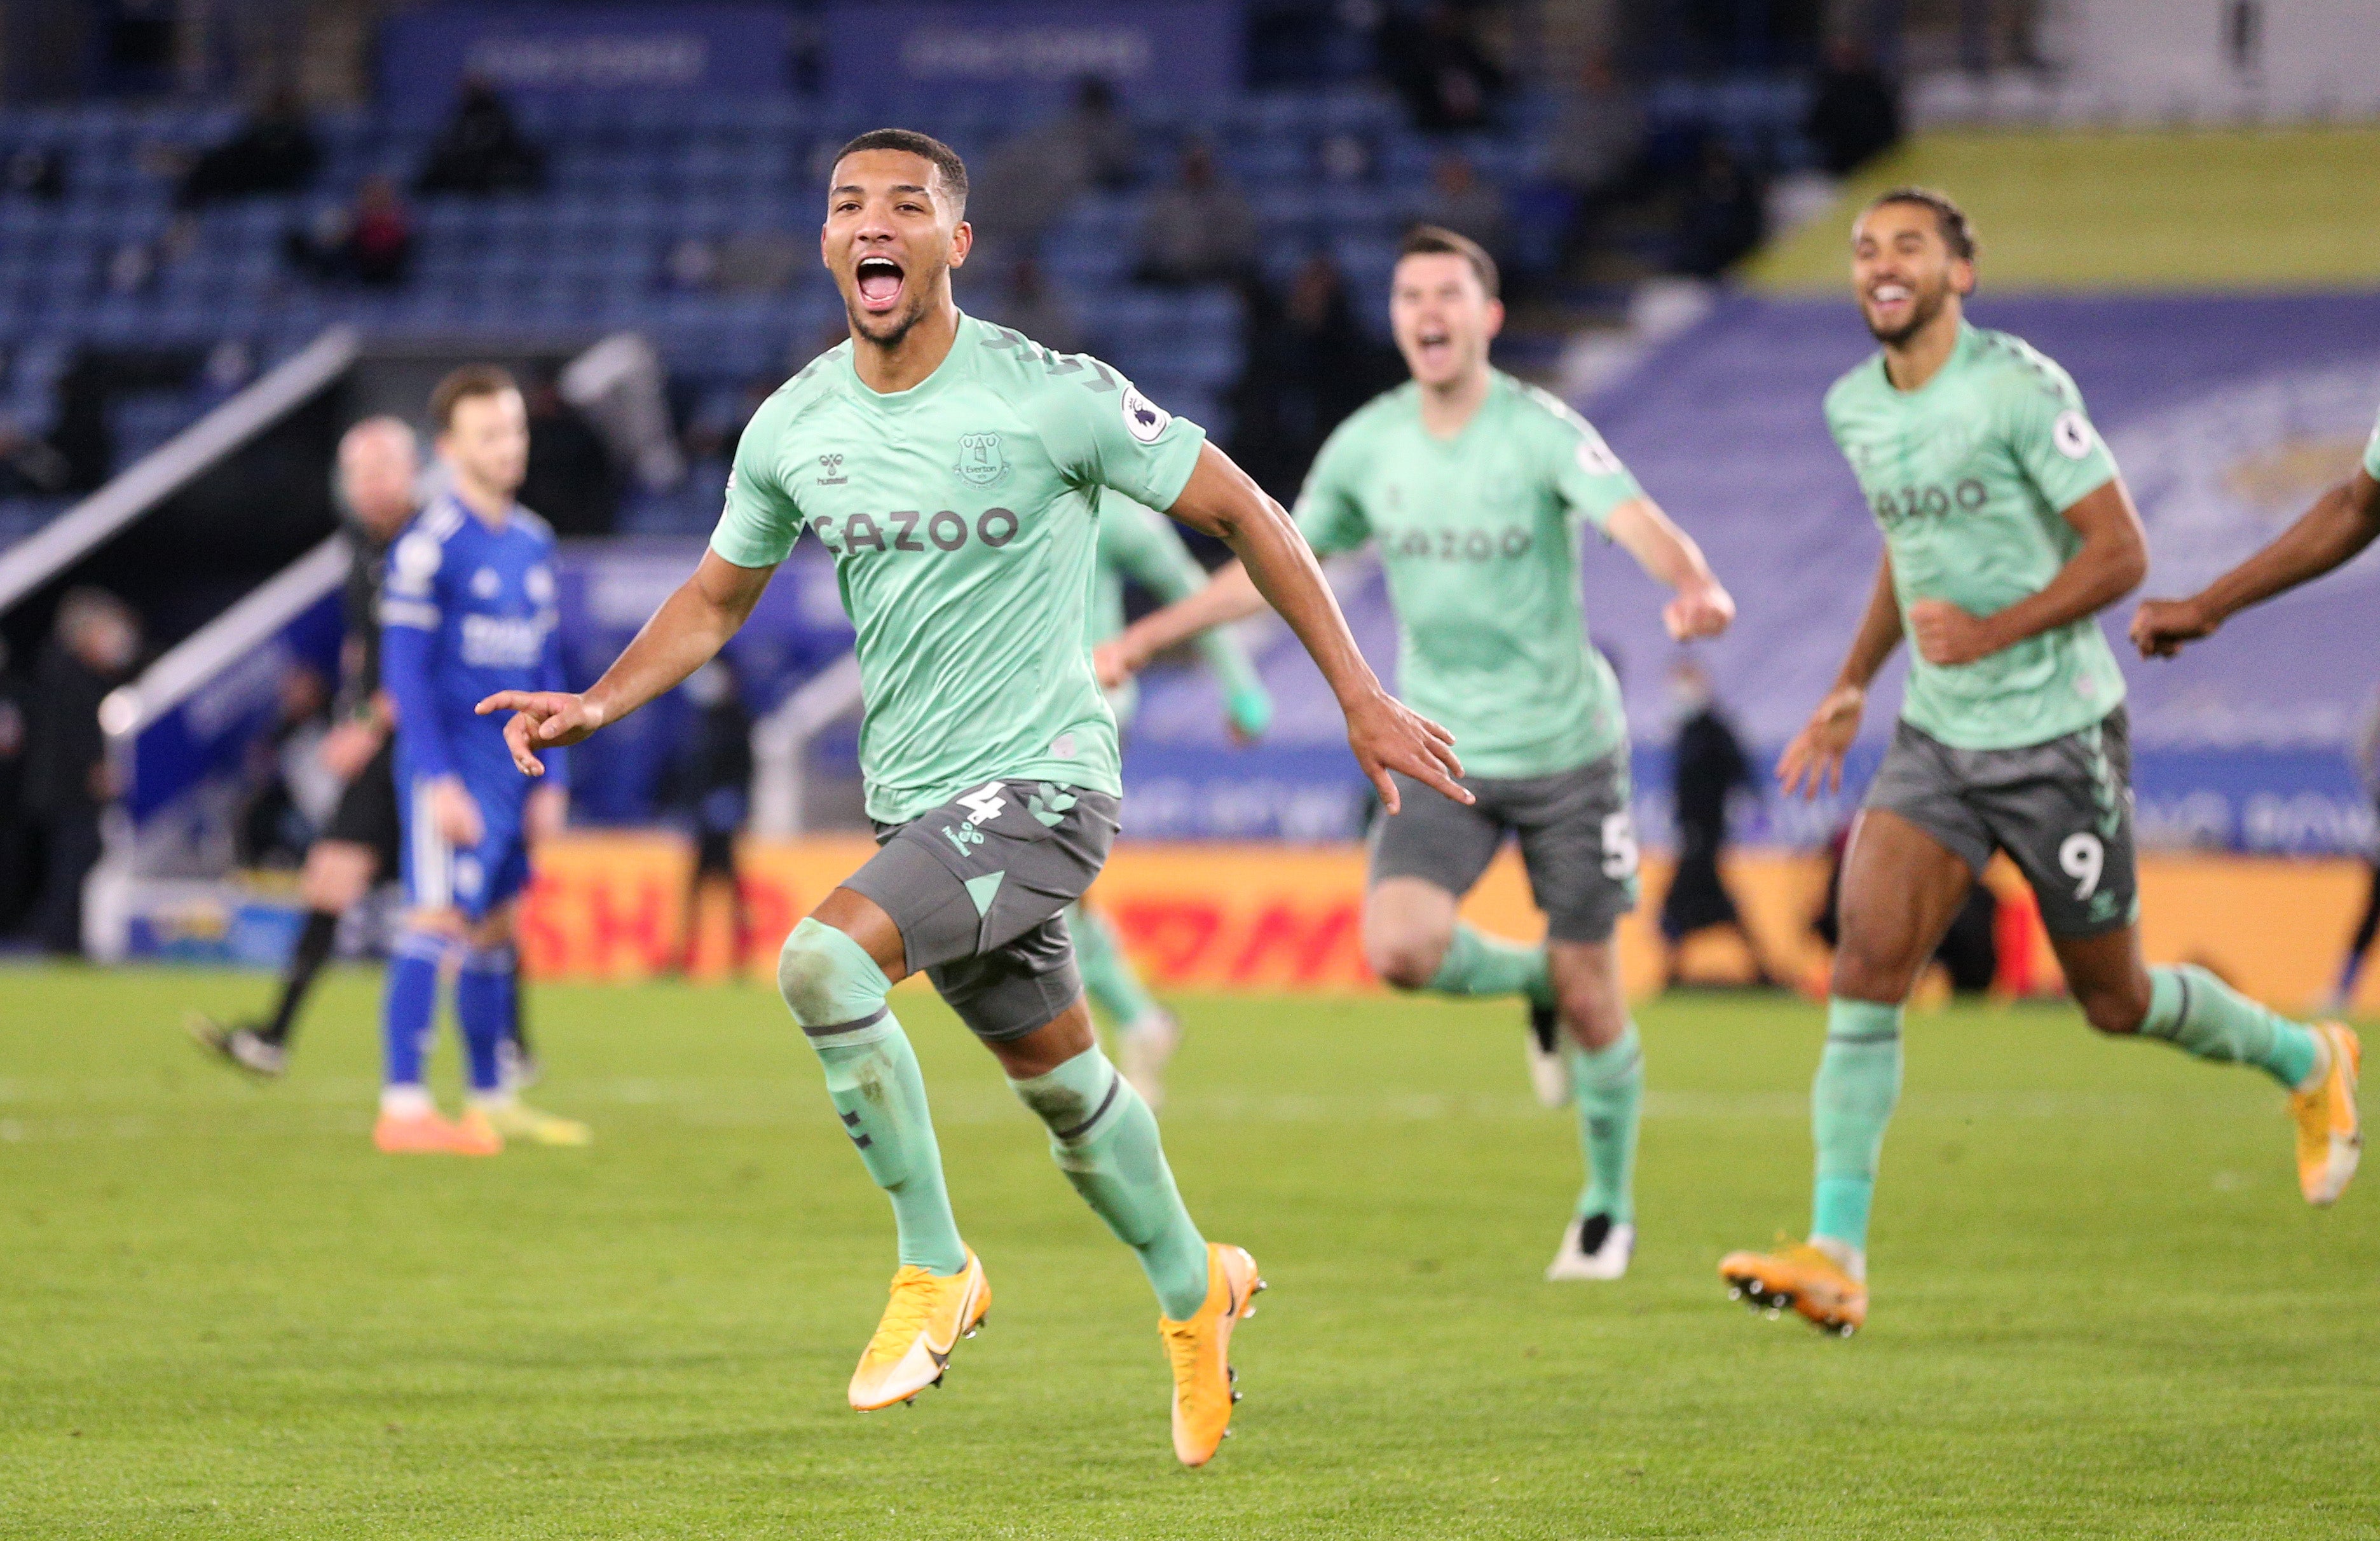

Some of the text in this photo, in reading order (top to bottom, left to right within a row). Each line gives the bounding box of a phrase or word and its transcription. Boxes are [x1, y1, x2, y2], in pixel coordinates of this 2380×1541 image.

[817, 476, 848, 485] hummel
[814, 507, 1019, 554] CAZOO
[955, 781, 1007, 826] 4
[941, 825, 972, 858] hummel
[1601, 811, 1639, 879] 5
[2058, 832, 2105, 902] 9
